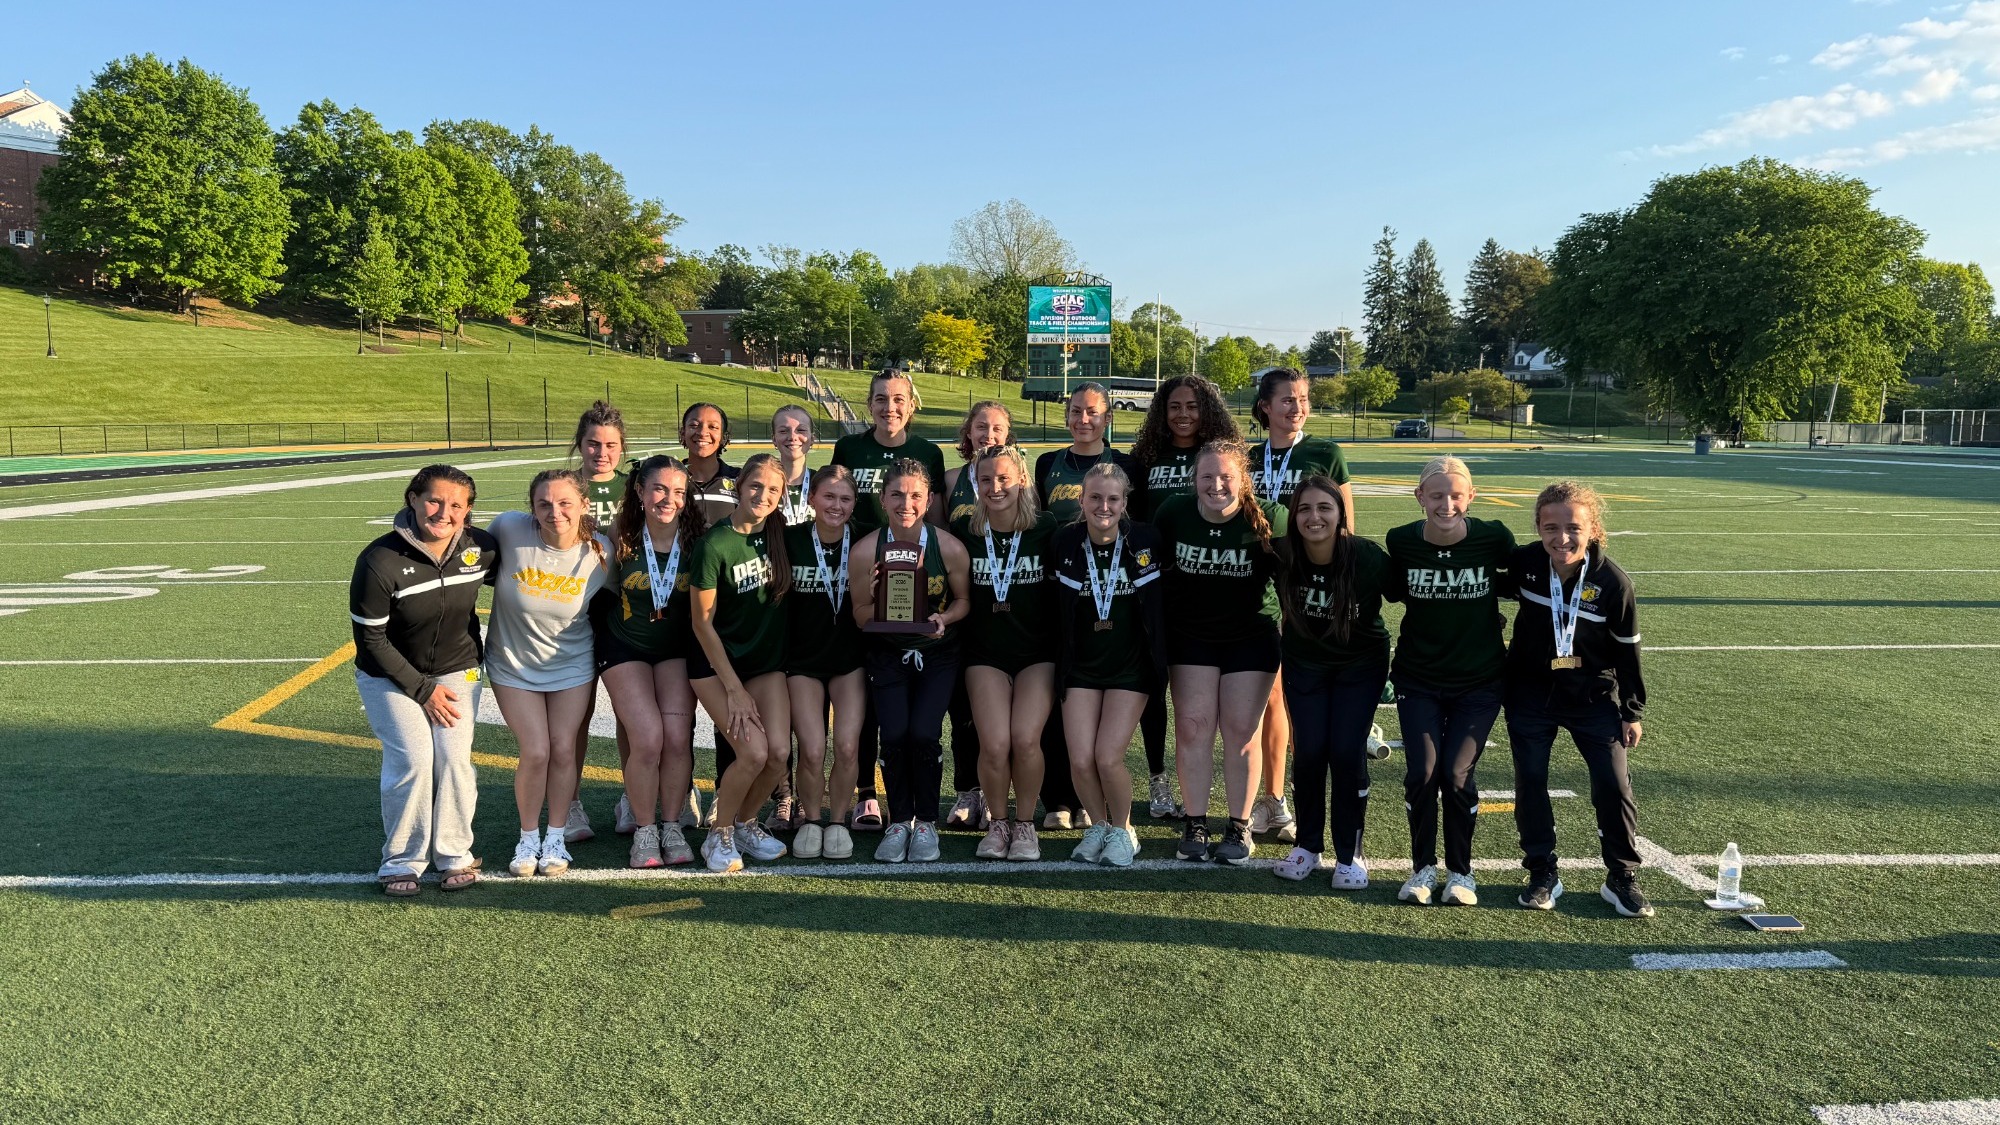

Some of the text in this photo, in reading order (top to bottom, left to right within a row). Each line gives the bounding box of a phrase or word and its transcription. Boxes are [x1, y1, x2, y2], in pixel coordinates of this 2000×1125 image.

[1054, 295, 1084, 305] ECAC
[853, 468, 884, 483] DEL
[1148, 465, 1195, 482] DELV
[1250, 469, 1303, 484] EVAL
[1048, 484, 1083, 506] AGG
[886, 550, 918, 560] ECAC
[1175, 541, 1253, 566] DELVAL
[1177, 558, 1201, 569] RACK
[1222, 564, 1252, 572] FIELD
[791, 565, 841, 581] DELV
[1220, 569, 1253, 578] UNIVERSITY
[1407, 565, 1489, 587] DELVAL
[1114, 581, 1134, 590] FIEL
[1409, 585, 1438, 594] RACK
[1460, 581, 1489, 593] FIELD
[1408, 589, 1433, 600] DELAWARE
[1458, 586, 1489, 600] UNIVERSITY
